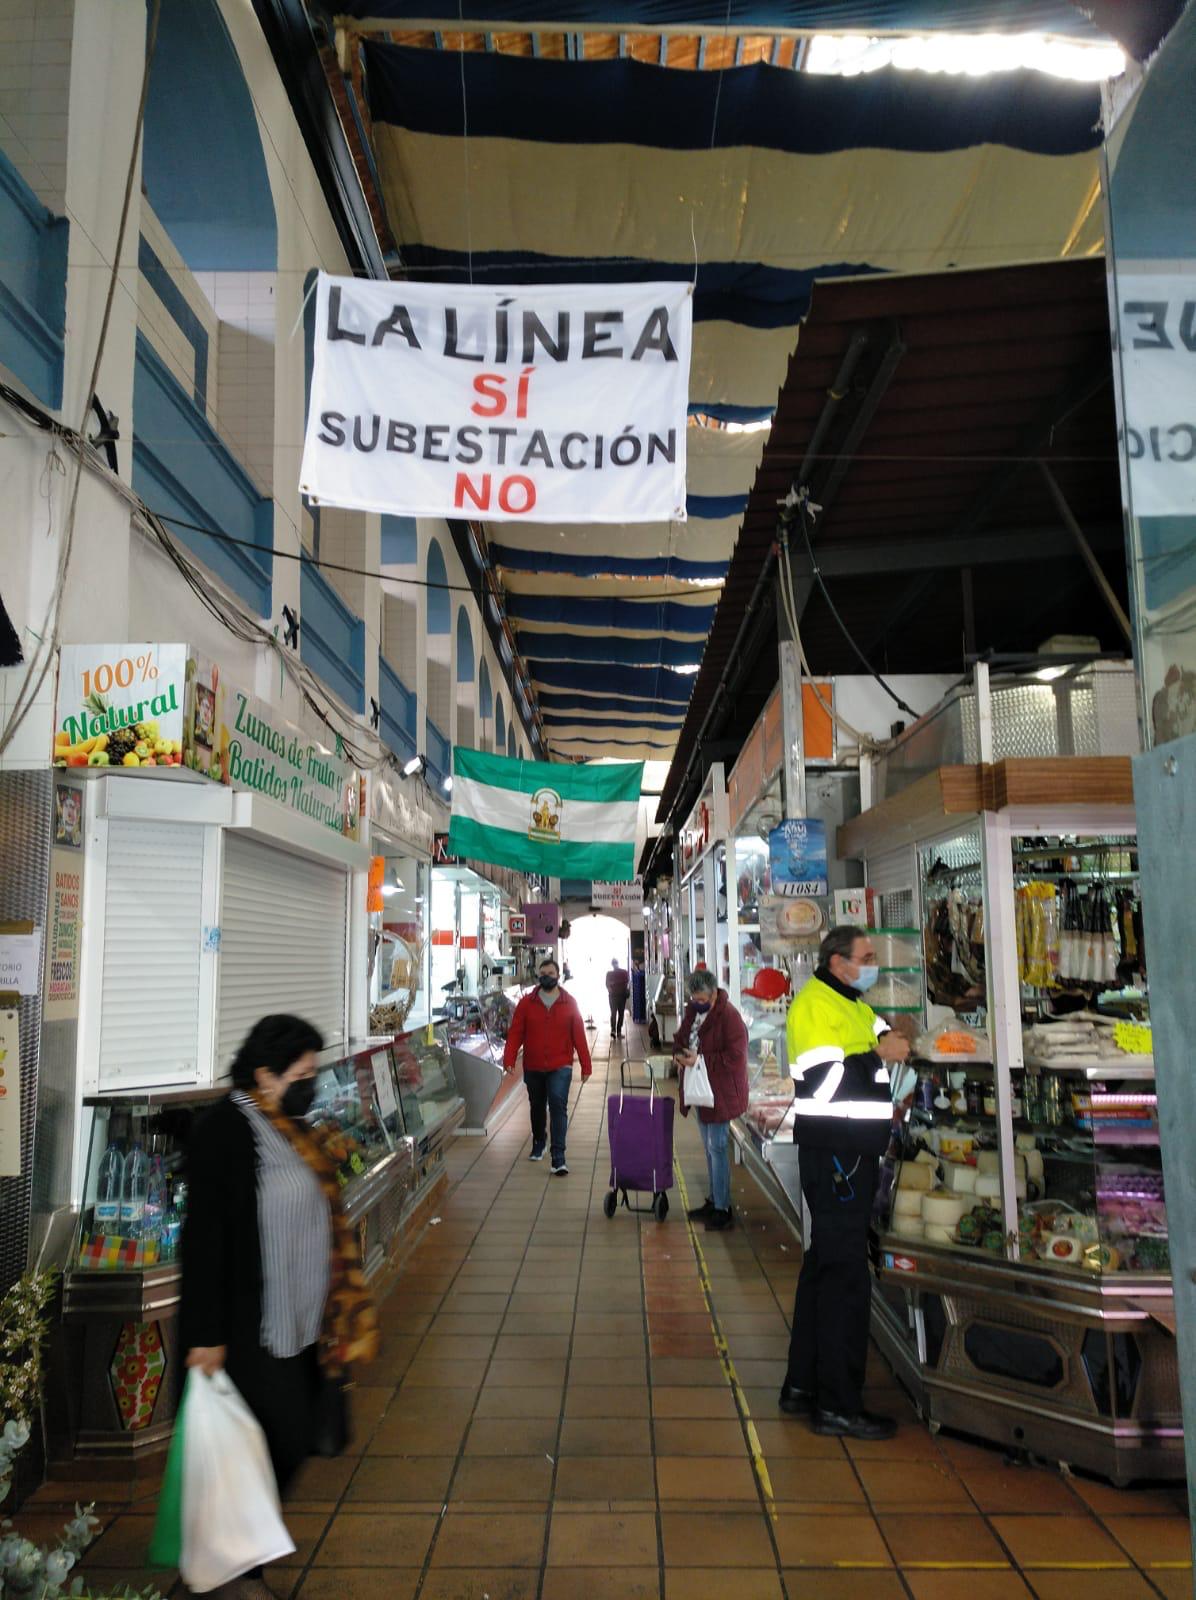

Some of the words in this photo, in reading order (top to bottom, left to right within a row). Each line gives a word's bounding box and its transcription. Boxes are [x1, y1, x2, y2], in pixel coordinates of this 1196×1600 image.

[327, 285, 422, 350] LA
[443, 298, 678, 363] LÍNEA
[471, 367, 537, 419] SÍ
[317, 411, 676, 470] SUBESTACIÓN
[453, 472, 537, 514] NO
[80, 651, 158, 698] 100%
[62, 683, 179, 745] Natural
[234, 693, 286, 759] Zumos
[288, 737, 302, 770] de
[306, 746, 334, 790] Fruta
[336, 777, 343, 803] y
[228, 740, 287, 803] Batidos
[290, 776, 344, 832] Naturales
[55, 872, 80, 890] BATIDOS
[60, 893, 79, 908] SANOS
